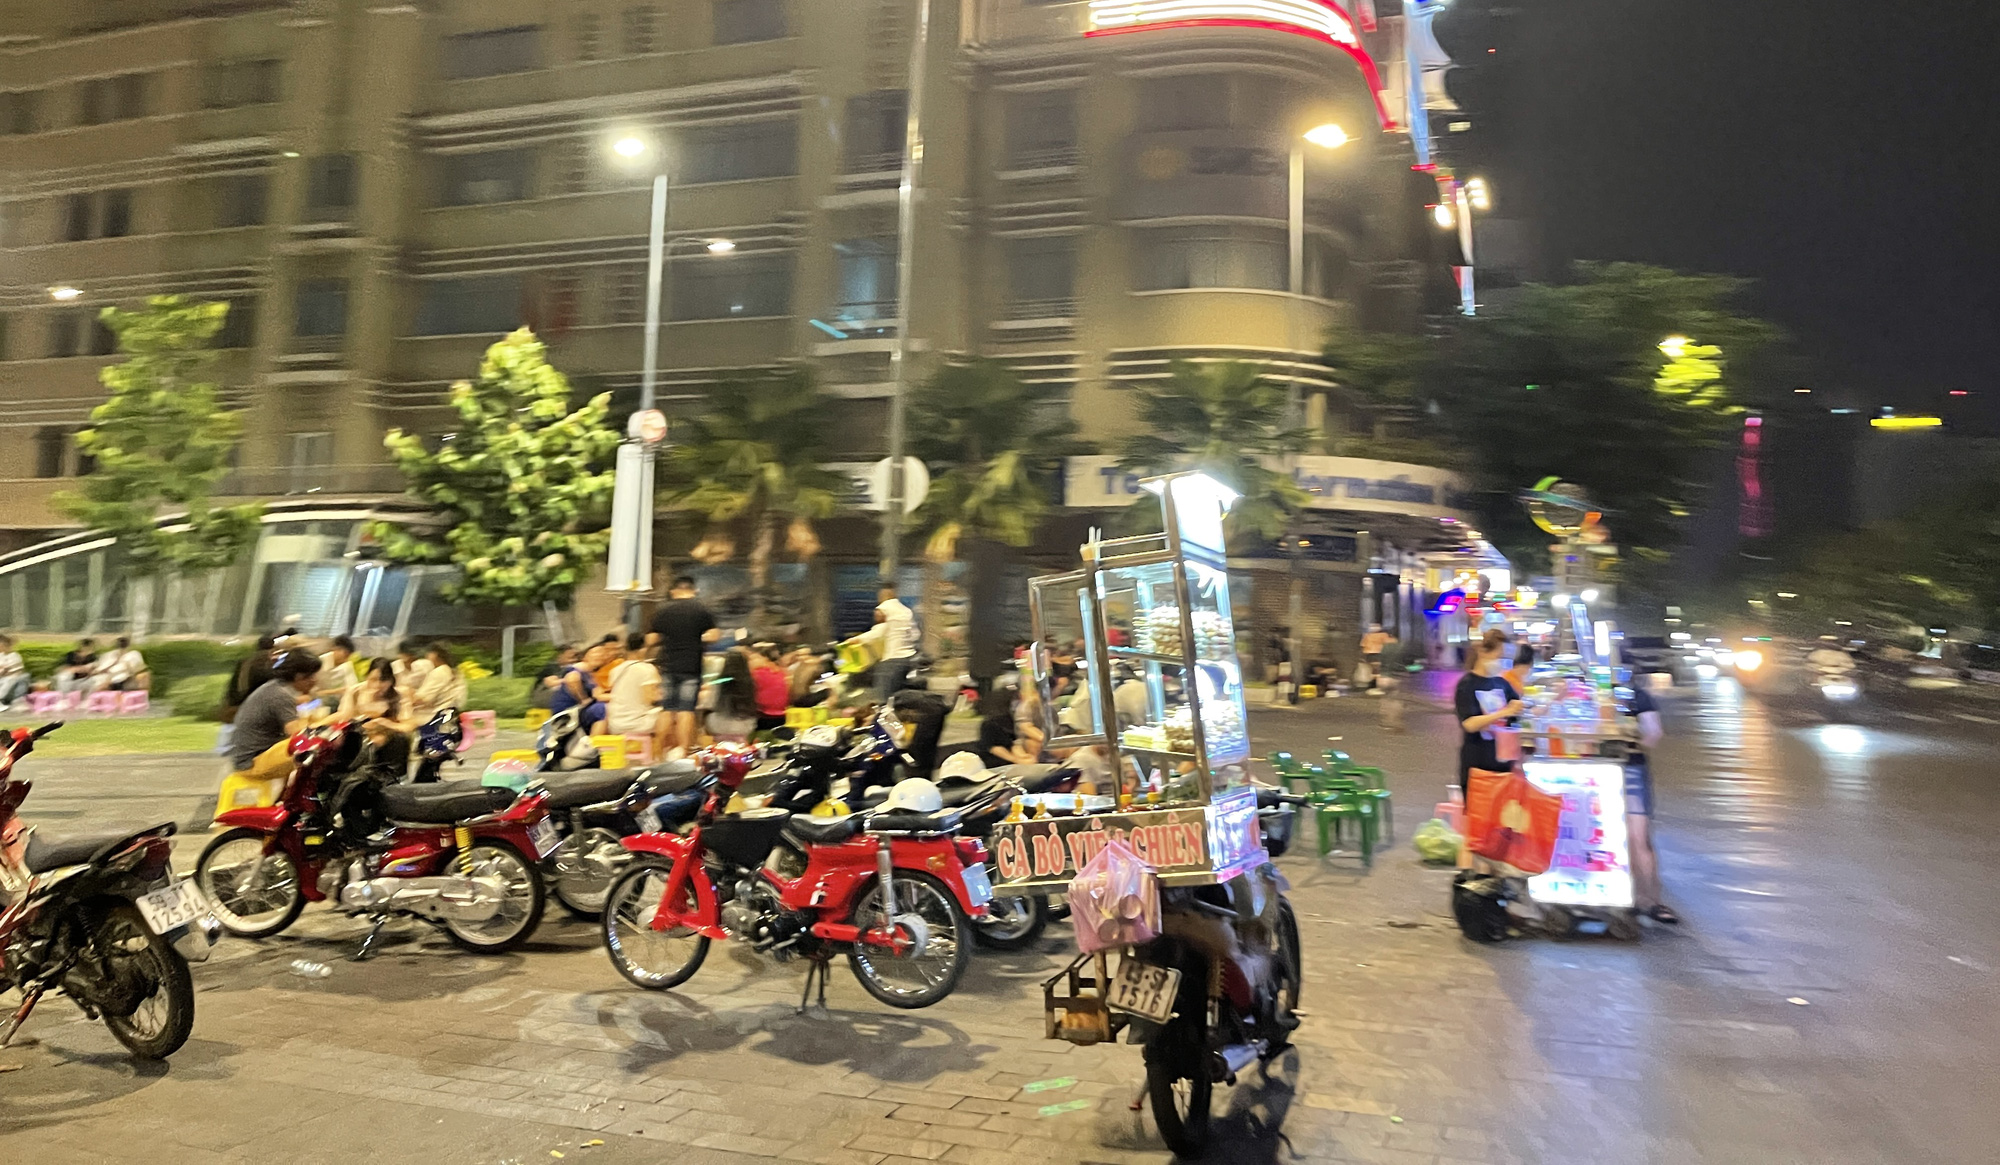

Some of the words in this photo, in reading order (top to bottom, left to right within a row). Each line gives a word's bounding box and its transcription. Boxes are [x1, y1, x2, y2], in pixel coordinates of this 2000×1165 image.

[1032, 822, 1065, 876] BÒ
[1129, 811, 1204, 867] CHIÊN
[1118, 984, 1162, 1013] 1516
